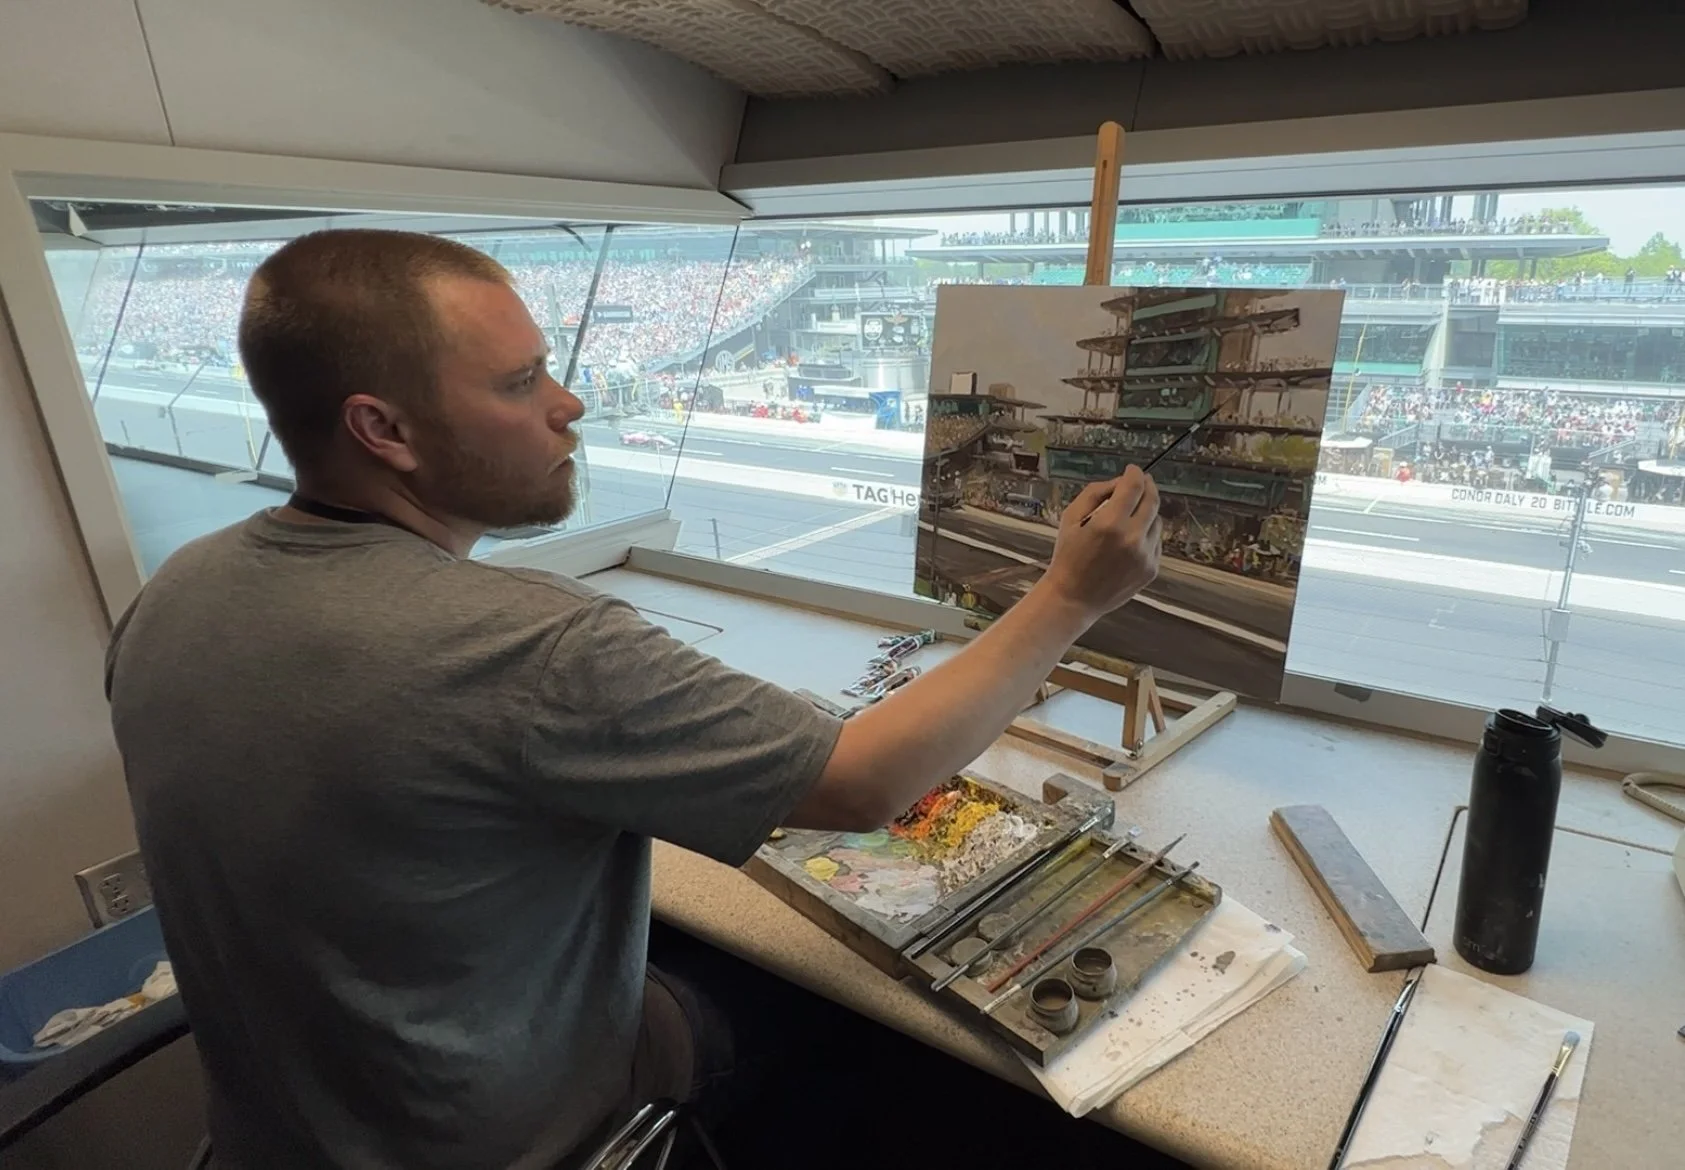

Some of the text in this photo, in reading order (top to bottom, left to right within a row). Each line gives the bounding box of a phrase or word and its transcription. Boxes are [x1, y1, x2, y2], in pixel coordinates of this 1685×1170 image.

[852, 484, 888, 503] TAG
[1452, 488, 1635, 517] CONOR DALY 20 BITLE.COM
